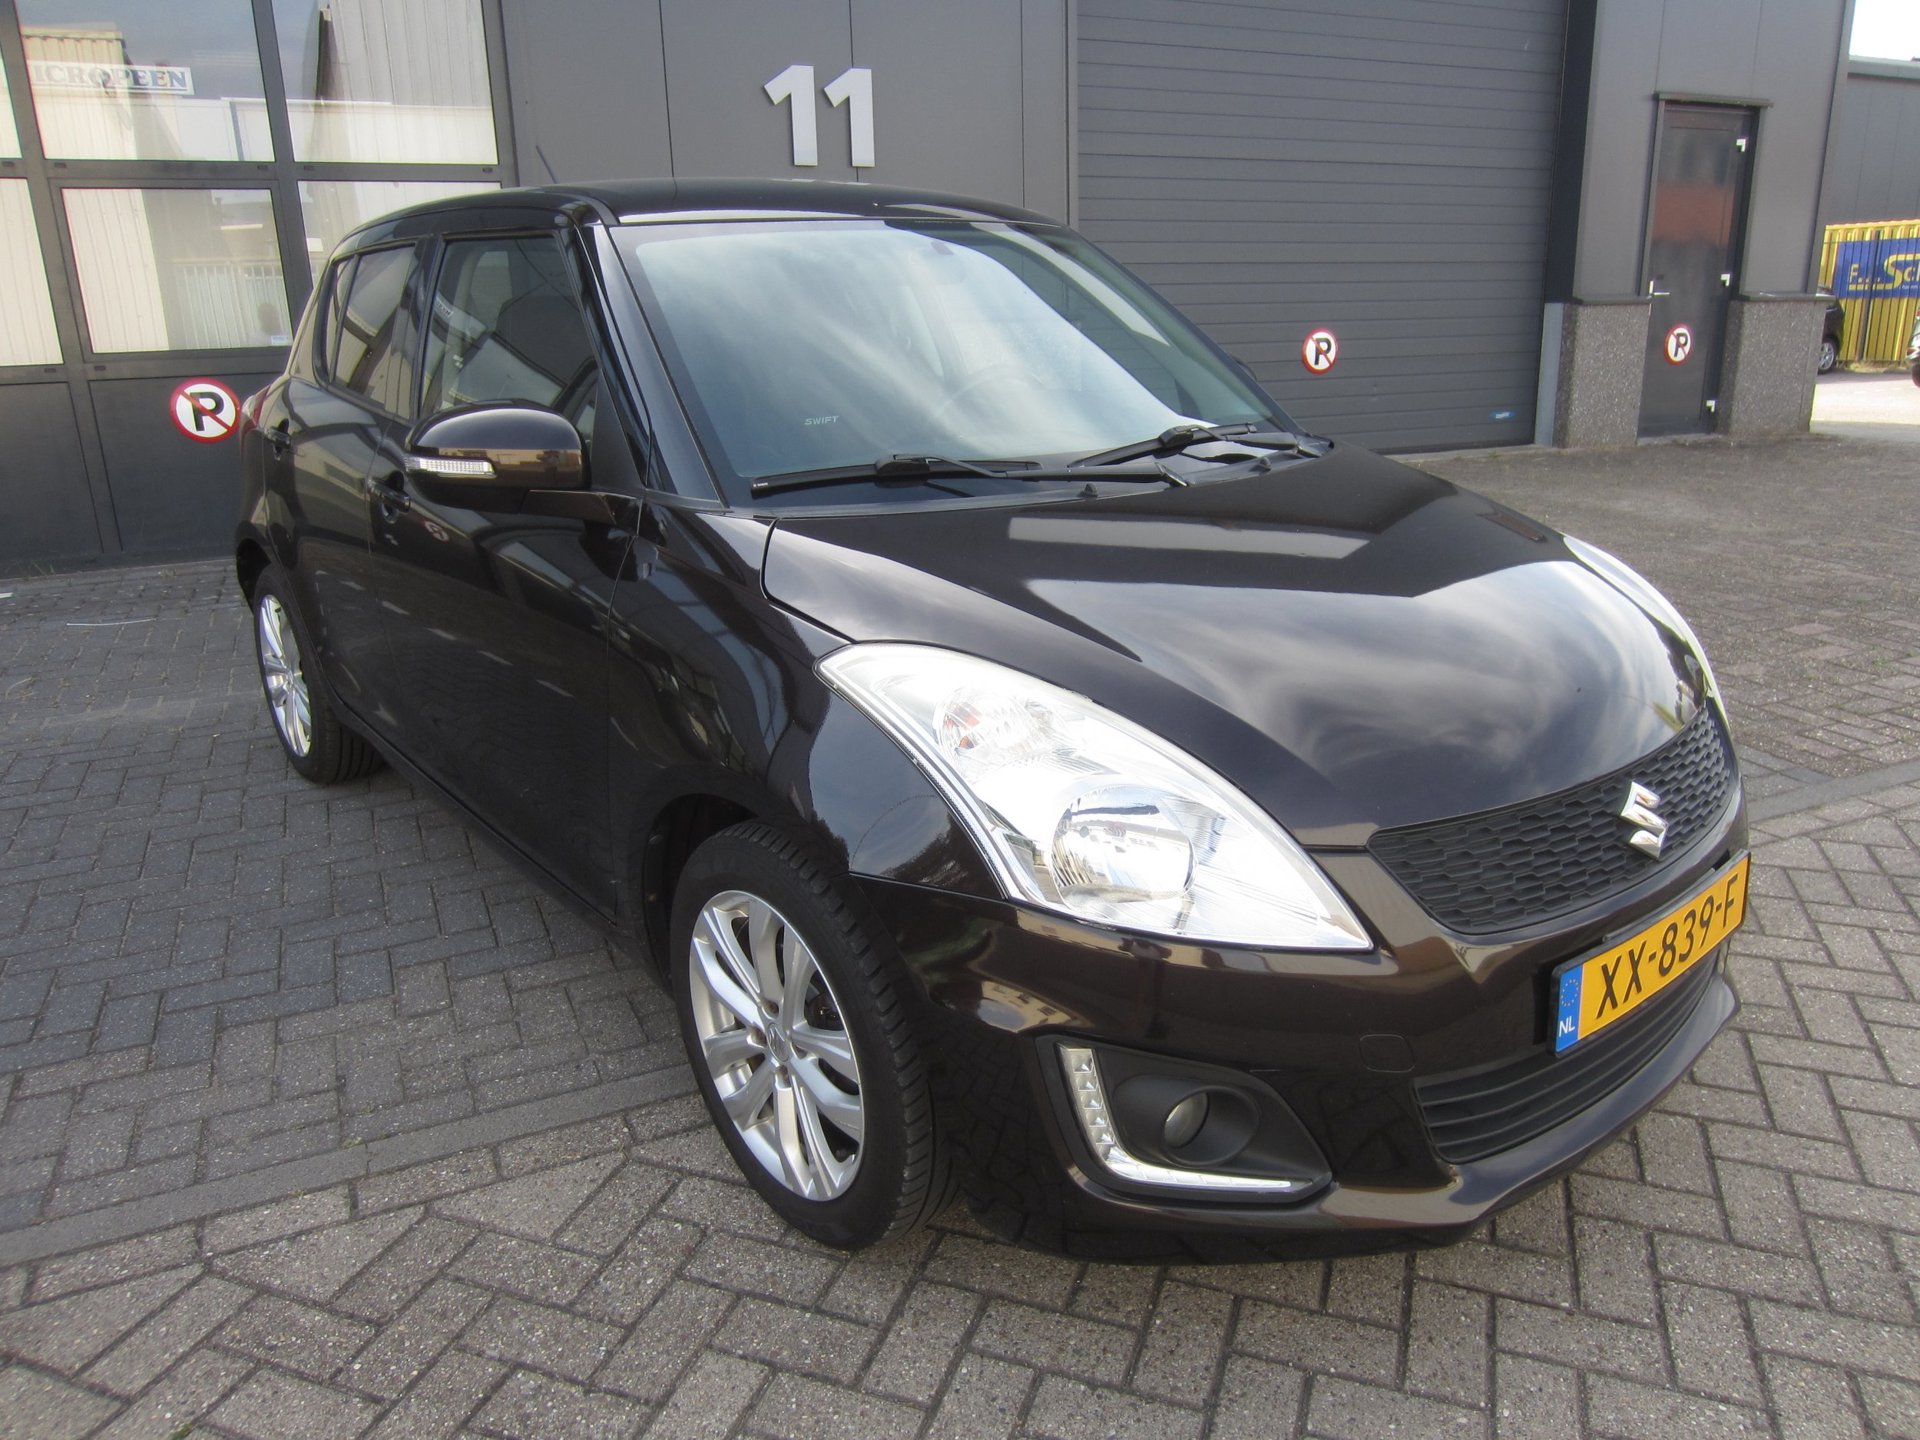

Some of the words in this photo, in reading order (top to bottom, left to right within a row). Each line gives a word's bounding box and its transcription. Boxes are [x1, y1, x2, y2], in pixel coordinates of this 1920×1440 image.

[763, 65, 876, 167] 11
[804, 415, 840, 426] SWIFT
[1596, 873, 1739, 1020] XX-839-F
[1558, 1015, 1576, 1038] NL
